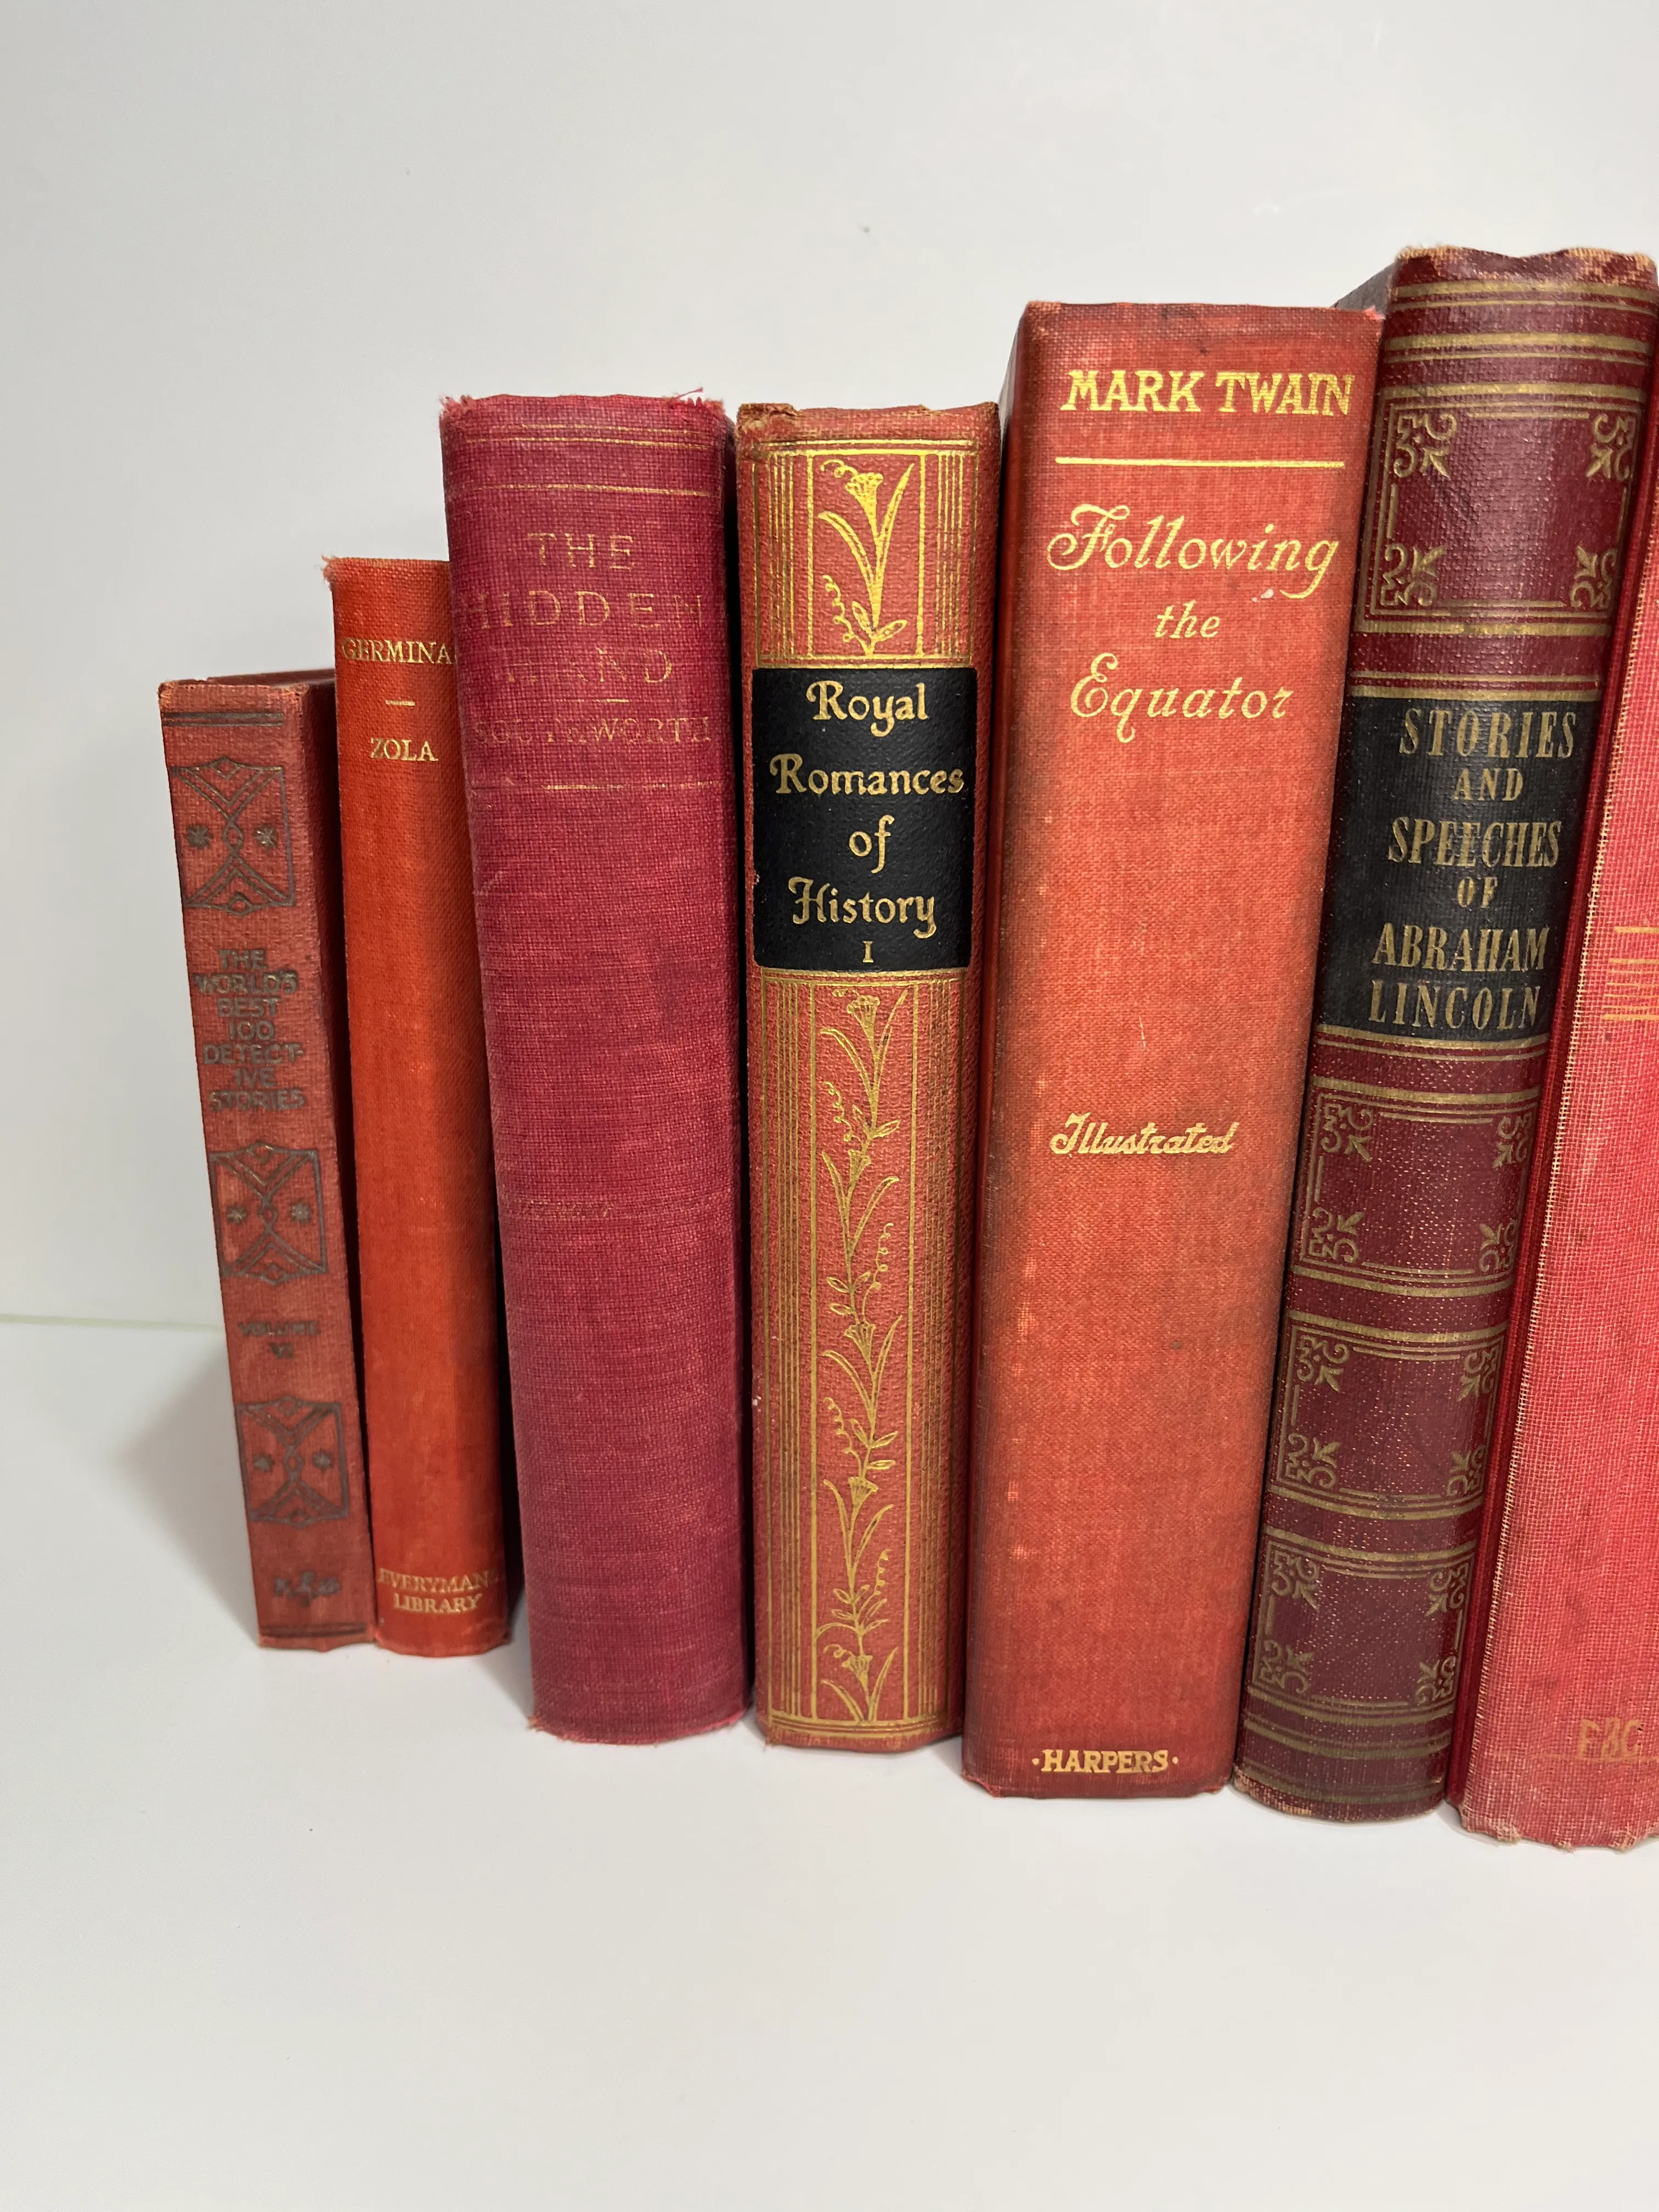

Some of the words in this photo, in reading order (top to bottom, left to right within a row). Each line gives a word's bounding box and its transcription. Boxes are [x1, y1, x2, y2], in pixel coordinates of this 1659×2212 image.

[1060, 369, 1205, 413] MARK
[1215, 371, 1355, 416] TWAIN
[526, 532, 633, 569] THE
[1047, 503, 1339, 600] Following
[1155, 599, 1221, 639] the
[342, 637, 457, 664] GERMINA
[806, 680, 929, 737] Royal
[1070, 652, 1294, 743] Equator
[370, 737, 439, 761] ZOLA
[1398, 708, 1577, 759] STORIES
[769, 753, 964, 795] Romances
[1453, 768, 1523, 802] AND
[849, 814, 895, 874] of
[1387, 815, 1561, 868] SPEECHES
[788, 876, 937, 939] History
[1457, 876, 1498, 909] OF
[217, 949, 268, 970] THE
[862, 940, 874, 963] I
[1372, 922, 1550, 973] ABRAHAM
[217, 996, 281, 1017] BEST
[1368, 979, 1540, 1031] LINCOLN
[229, 1020, 275, 1040] 100
[235, 1068, 275, 1087] IVE
[209, 1088, 306, 1111] STORIES
[1049, 1111, 1240, 1155] Illustrated
[238, 1320, 320, 1336] VOLUME
[394, 1592, 483, 1613] LIBRARY
